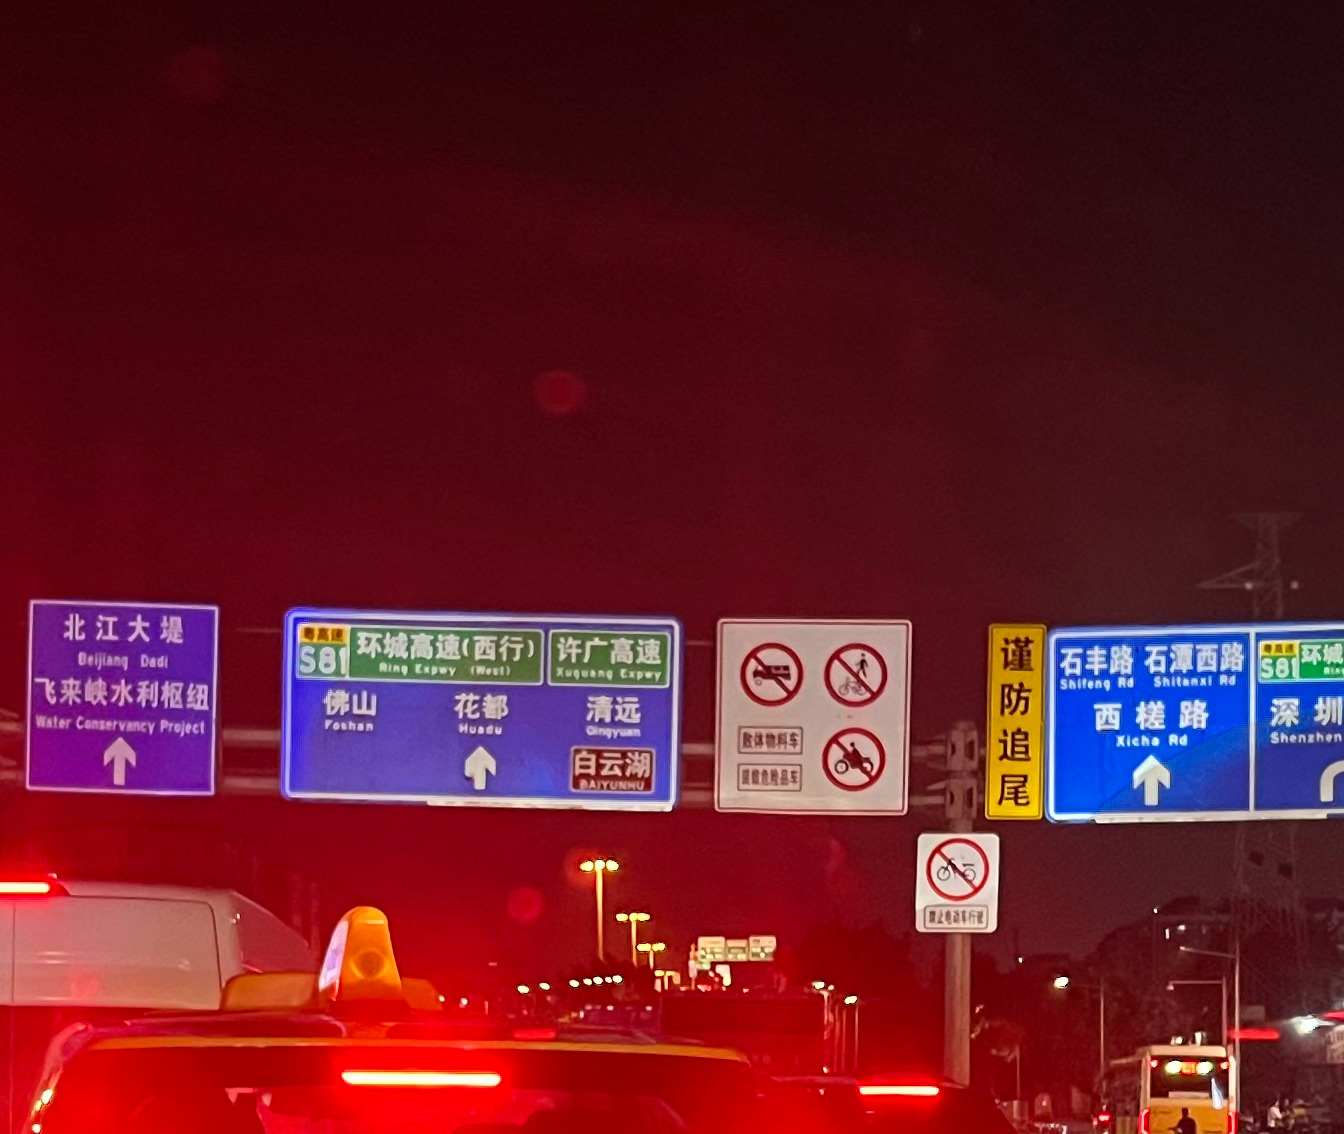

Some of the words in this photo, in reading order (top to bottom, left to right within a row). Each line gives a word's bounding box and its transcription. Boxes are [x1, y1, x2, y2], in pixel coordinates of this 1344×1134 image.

[63, 613, 184, 643] 北江大堤
[357, 632, 534, 661] 环城高速(西行)
[557, 637, 662, 665] 许广高速
[78, 652, 128, 670] Beijiang
[140, 655, 168, 669] Dadi
[299, 647, 347, 674] S81
[1060, 646, 1134, 676] 石丰路
[1145, 644, 1244, 675] 石潭西路
[1261, 657, 1298, 679] S81
[557, 668, 613, 681] Xuguang
[1118, 677, 1133, 688] Rd
[1219, 675, 1236, 687] Rd
[34, 678, 209, 710] 飞来峡水利枢纽
[324, 690, 377, 716] 佛山
[454, 692, 508, 720] 花都
[586, 695, 641, 723] 清远
[997, 636, 1035, 807] 谨防追尾
[1270, 697, 1343, 727] 深圳
[36, 715, 71, 729] Water
[76, 716, 155, 735] Conservancy
[160, 719, 205, 737] Project
[324, 720, 374, 731] Foshan
[459, 724, 503, 735] Huadu
[586, 726, 641, 738] Qingyuan
[1270, 732, 1342, 744] Shenzhen
[1116, 734, 1159, 747] Xicha
[1169, 734, 1188, 747] Rd
[574, 751, 651, 777] 白云湖
[579, 779, 645, 791] BAIYUNHU
